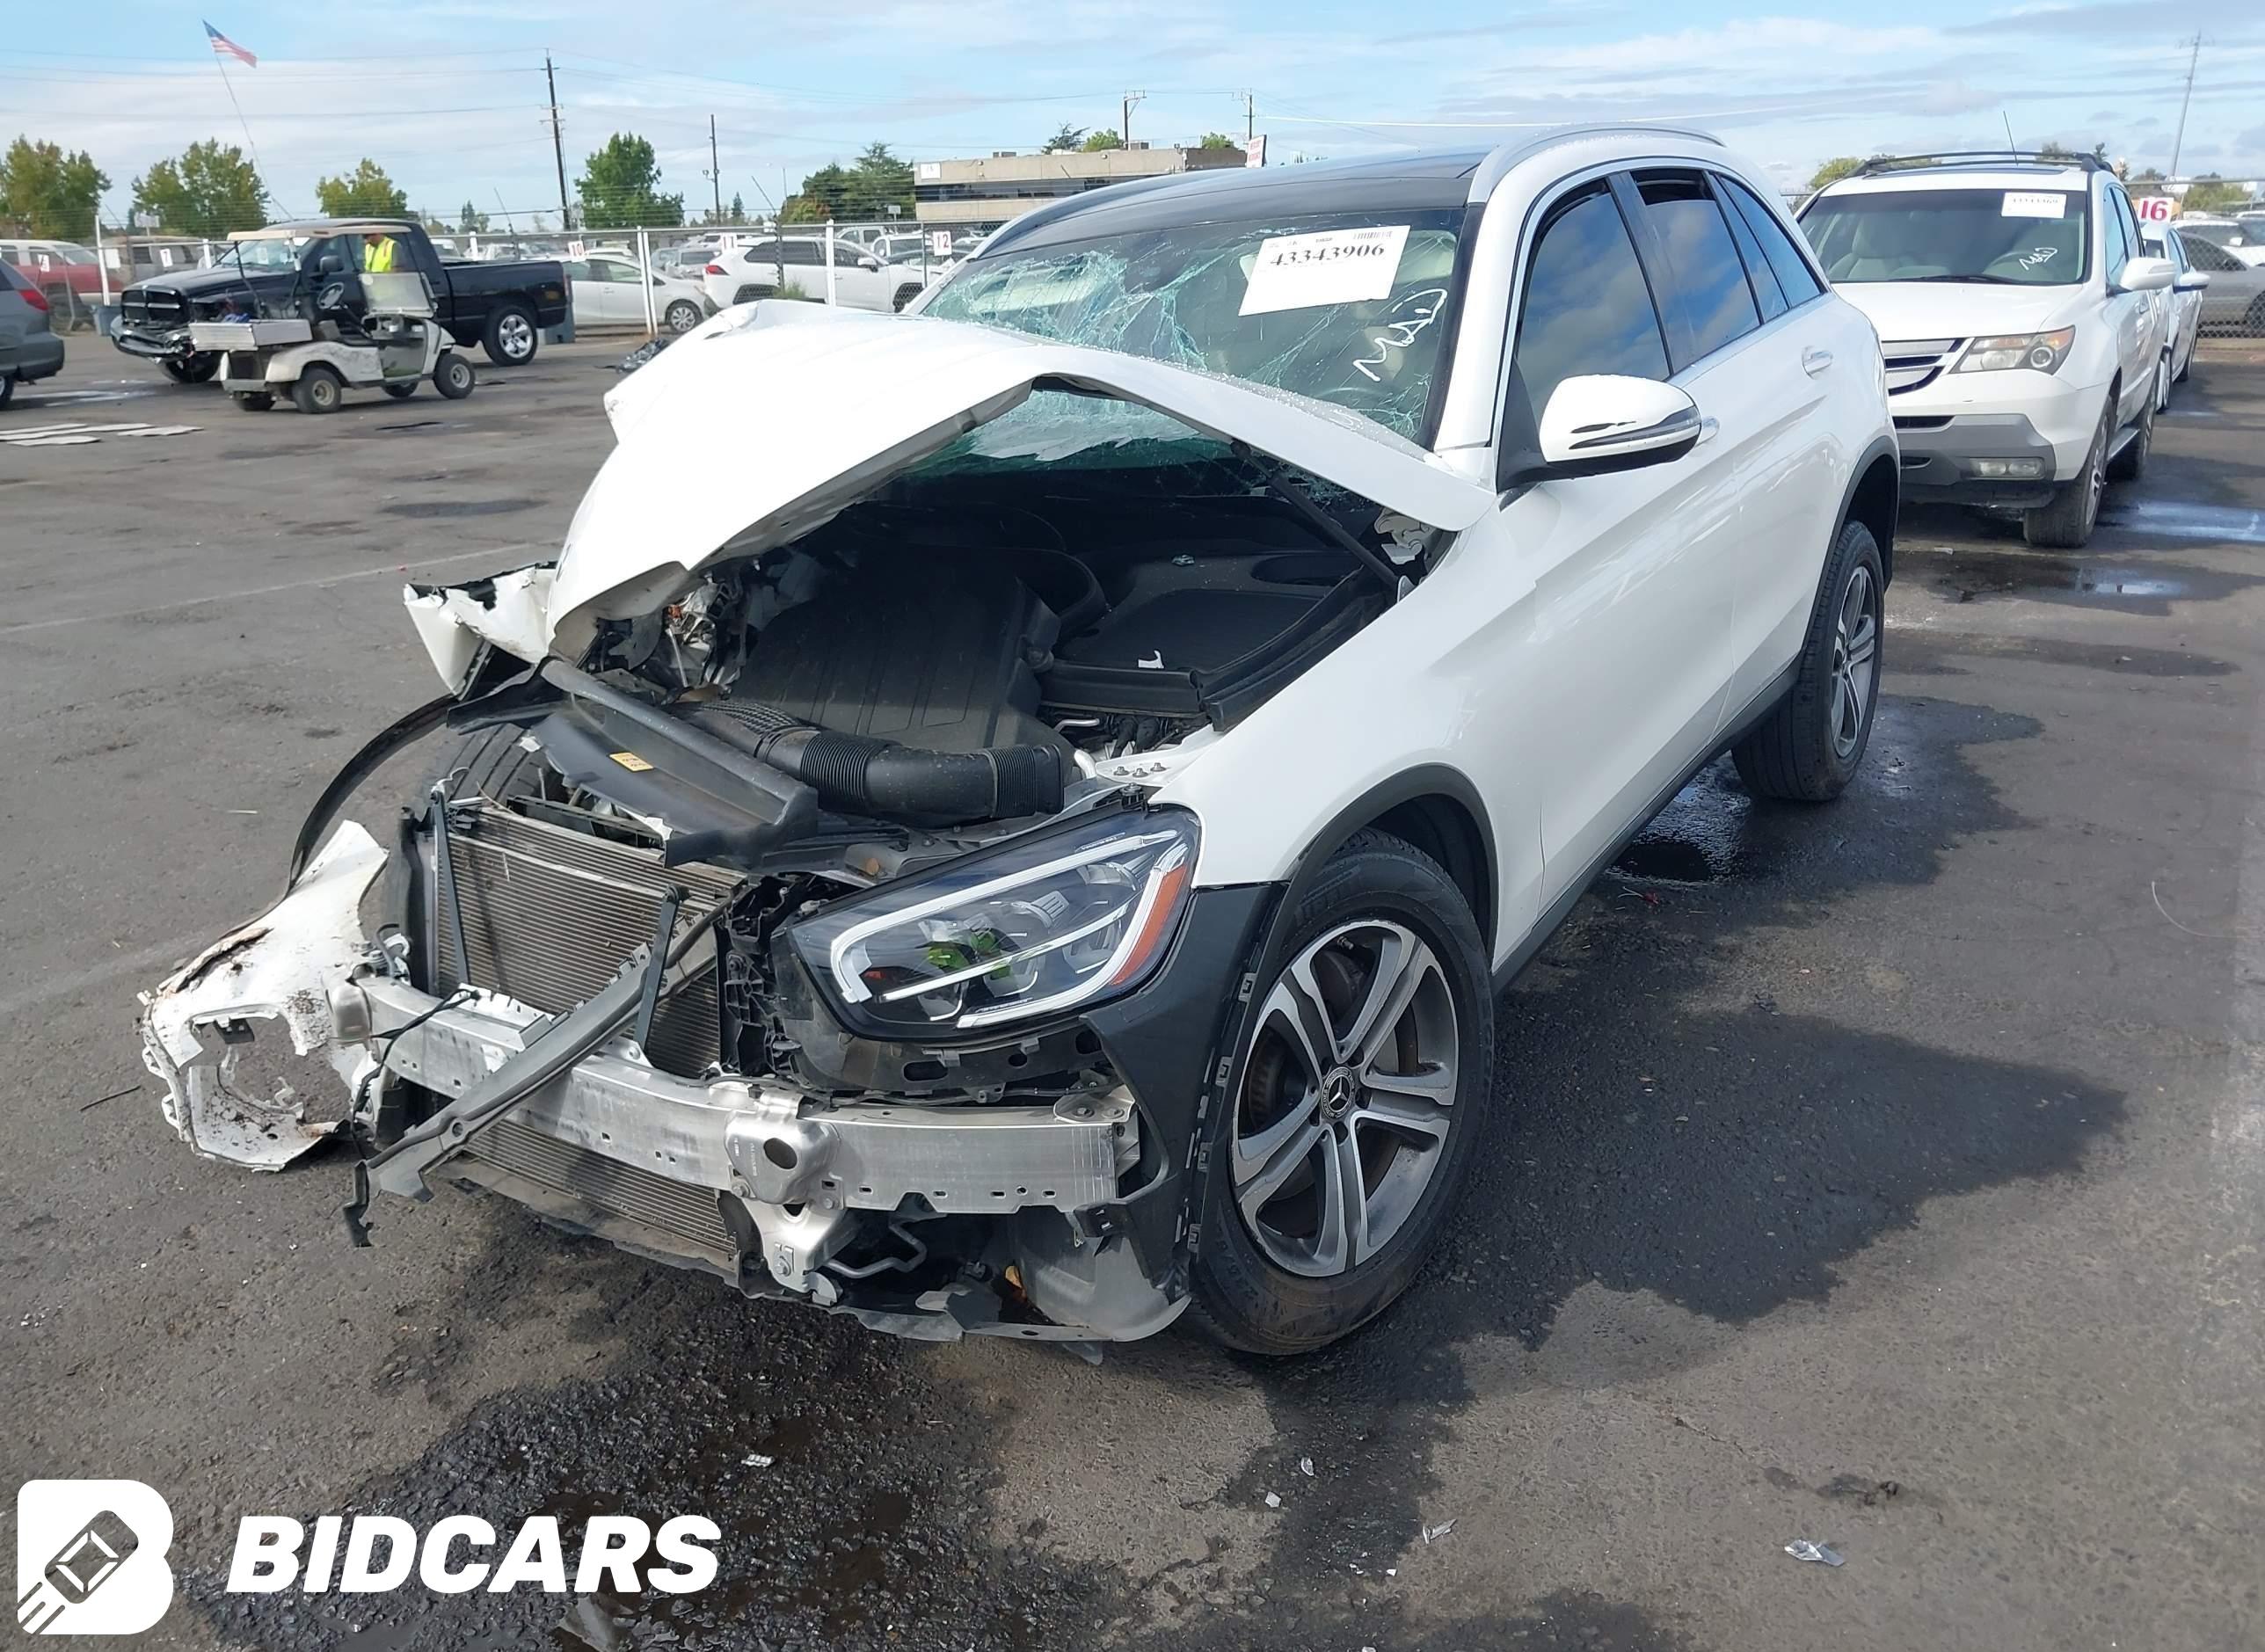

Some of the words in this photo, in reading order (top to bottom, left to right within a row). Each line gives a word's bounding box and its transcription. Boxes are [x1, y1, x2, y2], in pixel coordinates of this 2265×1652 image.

[2140, 199, 2169, 222] 16
[571, 242, 585, 257] 10
[936, 233, 950, 249] 12
[1270, 244, 1386, 266] 43343906
